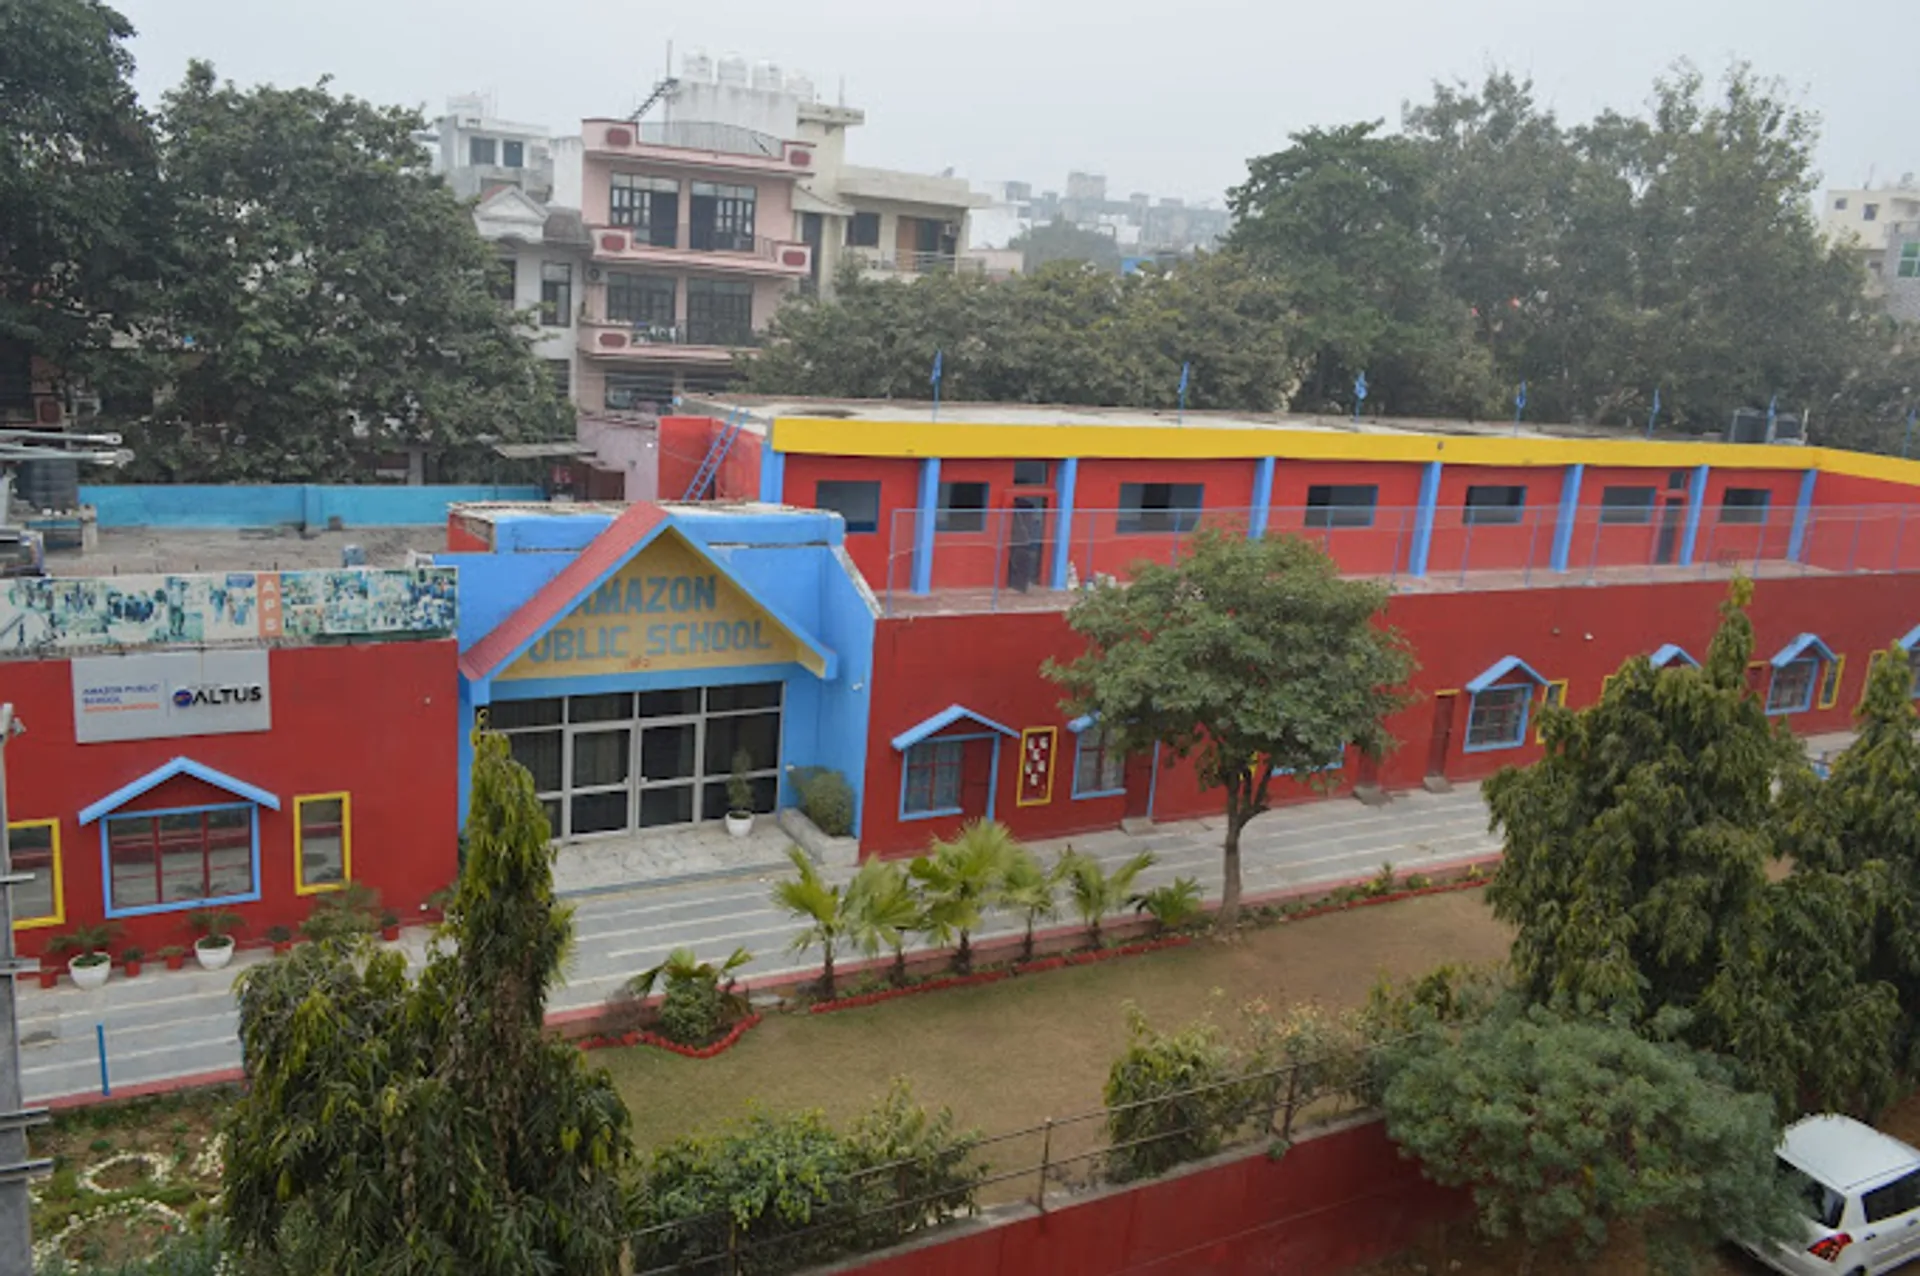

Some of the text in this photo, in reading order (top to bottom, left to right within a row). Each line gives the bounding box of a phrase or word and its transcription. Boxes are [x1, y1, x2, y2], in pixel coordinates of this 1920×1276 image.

[528, 619, 772, 662] UBLIC SCHOOL
[192, 686, 262, 705] ALTUS
